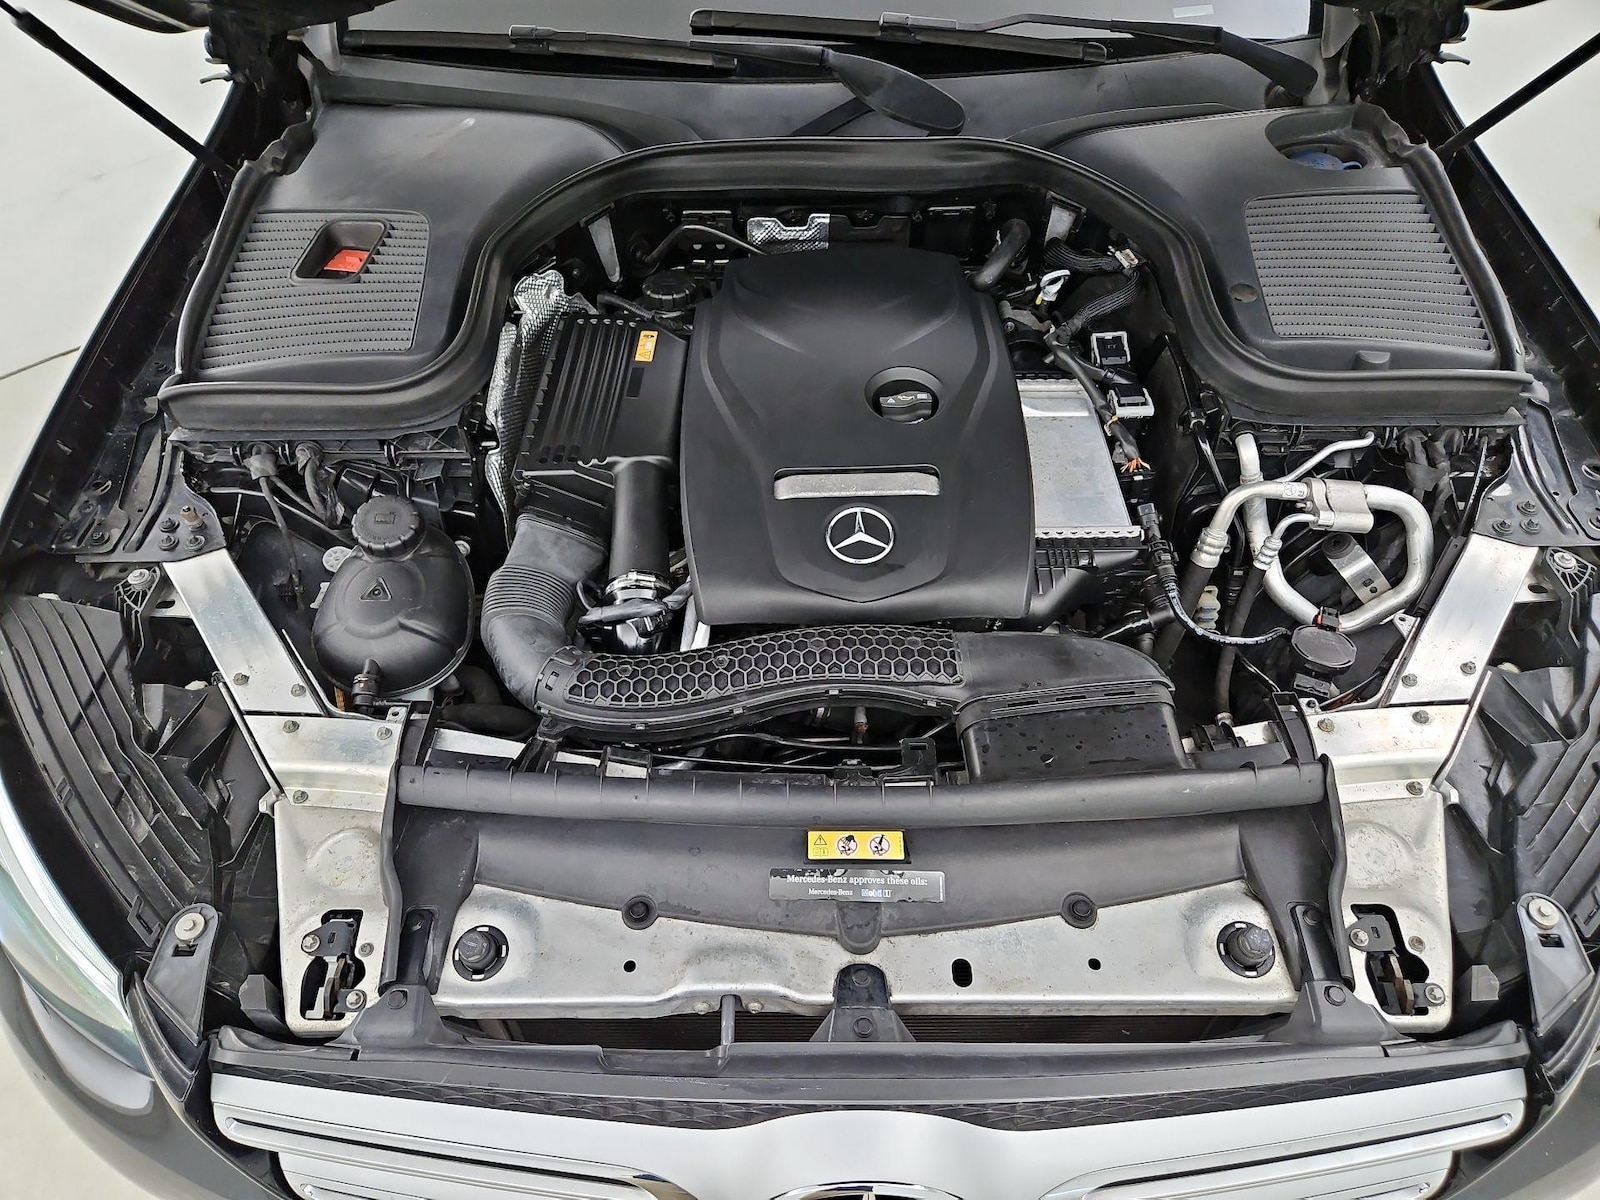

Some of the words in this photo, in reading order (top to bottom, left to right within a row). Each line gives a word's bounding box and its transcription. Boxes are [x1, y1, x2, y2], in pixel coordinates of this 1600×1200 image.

[786, 874, 848, 884] Mercedes-Benz
[848, 877, 885, 886] approves
[887, 876, 909, 885] these
[910, 877, 928, 886] oils:
[808, 888, 853, 896] Mercedes-Benz
[861, 888, 883, 898] Mobil
